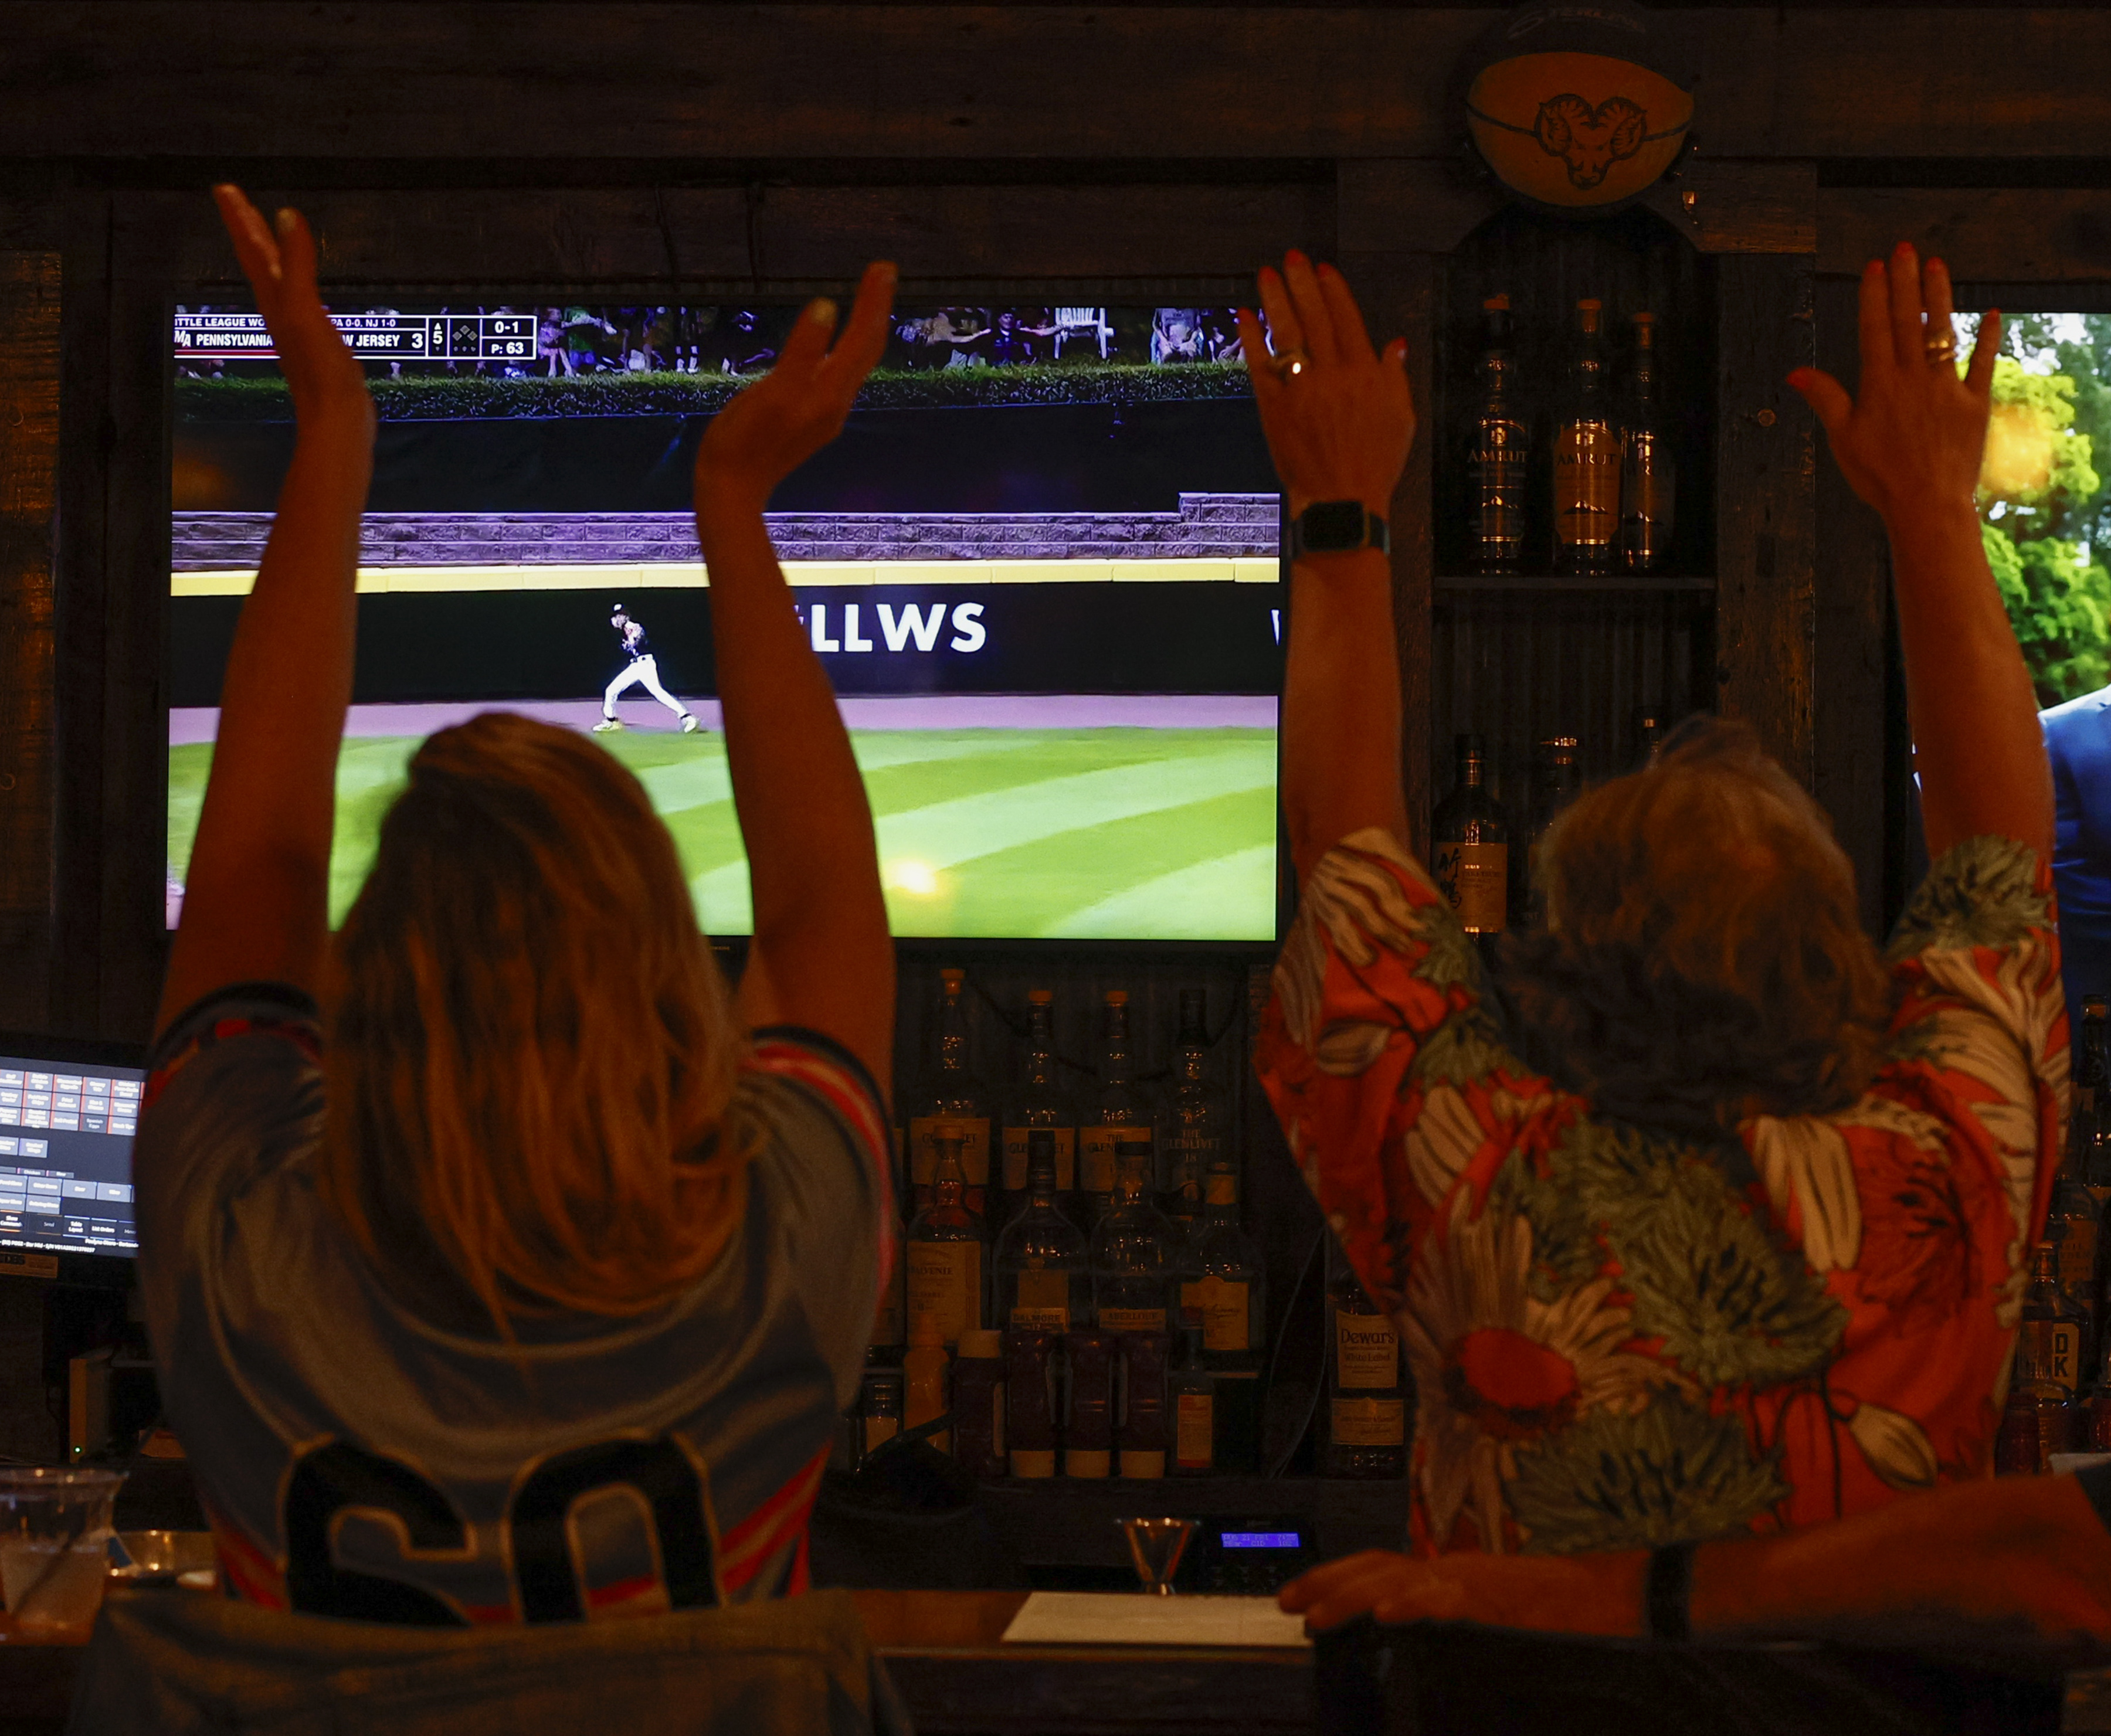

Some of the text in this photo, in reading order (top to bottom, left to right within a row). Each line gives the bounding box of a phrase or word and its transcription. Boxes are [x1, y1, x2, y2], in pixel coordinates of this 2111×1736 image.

[205, 318, 246, 327] LEAGUE
[365, 319, 378, 327] NJ
[382, 320, 396, 328] 1-0
[494, 321, 519, 334] 0-1
[196, 334, 273, 347] PENNSYLVANIA
[356, 334, 400, 347] JERSEY
[411, 332, 423, 348] 3
[433, 331, 443, 345] 5
[491, 342, 524, 354] P: 63
[1467, 449, 1528, 463] AMRUT
[1557, 452, 1617, 466] AMRUT
[794, 602, 986, 653] LLWS
